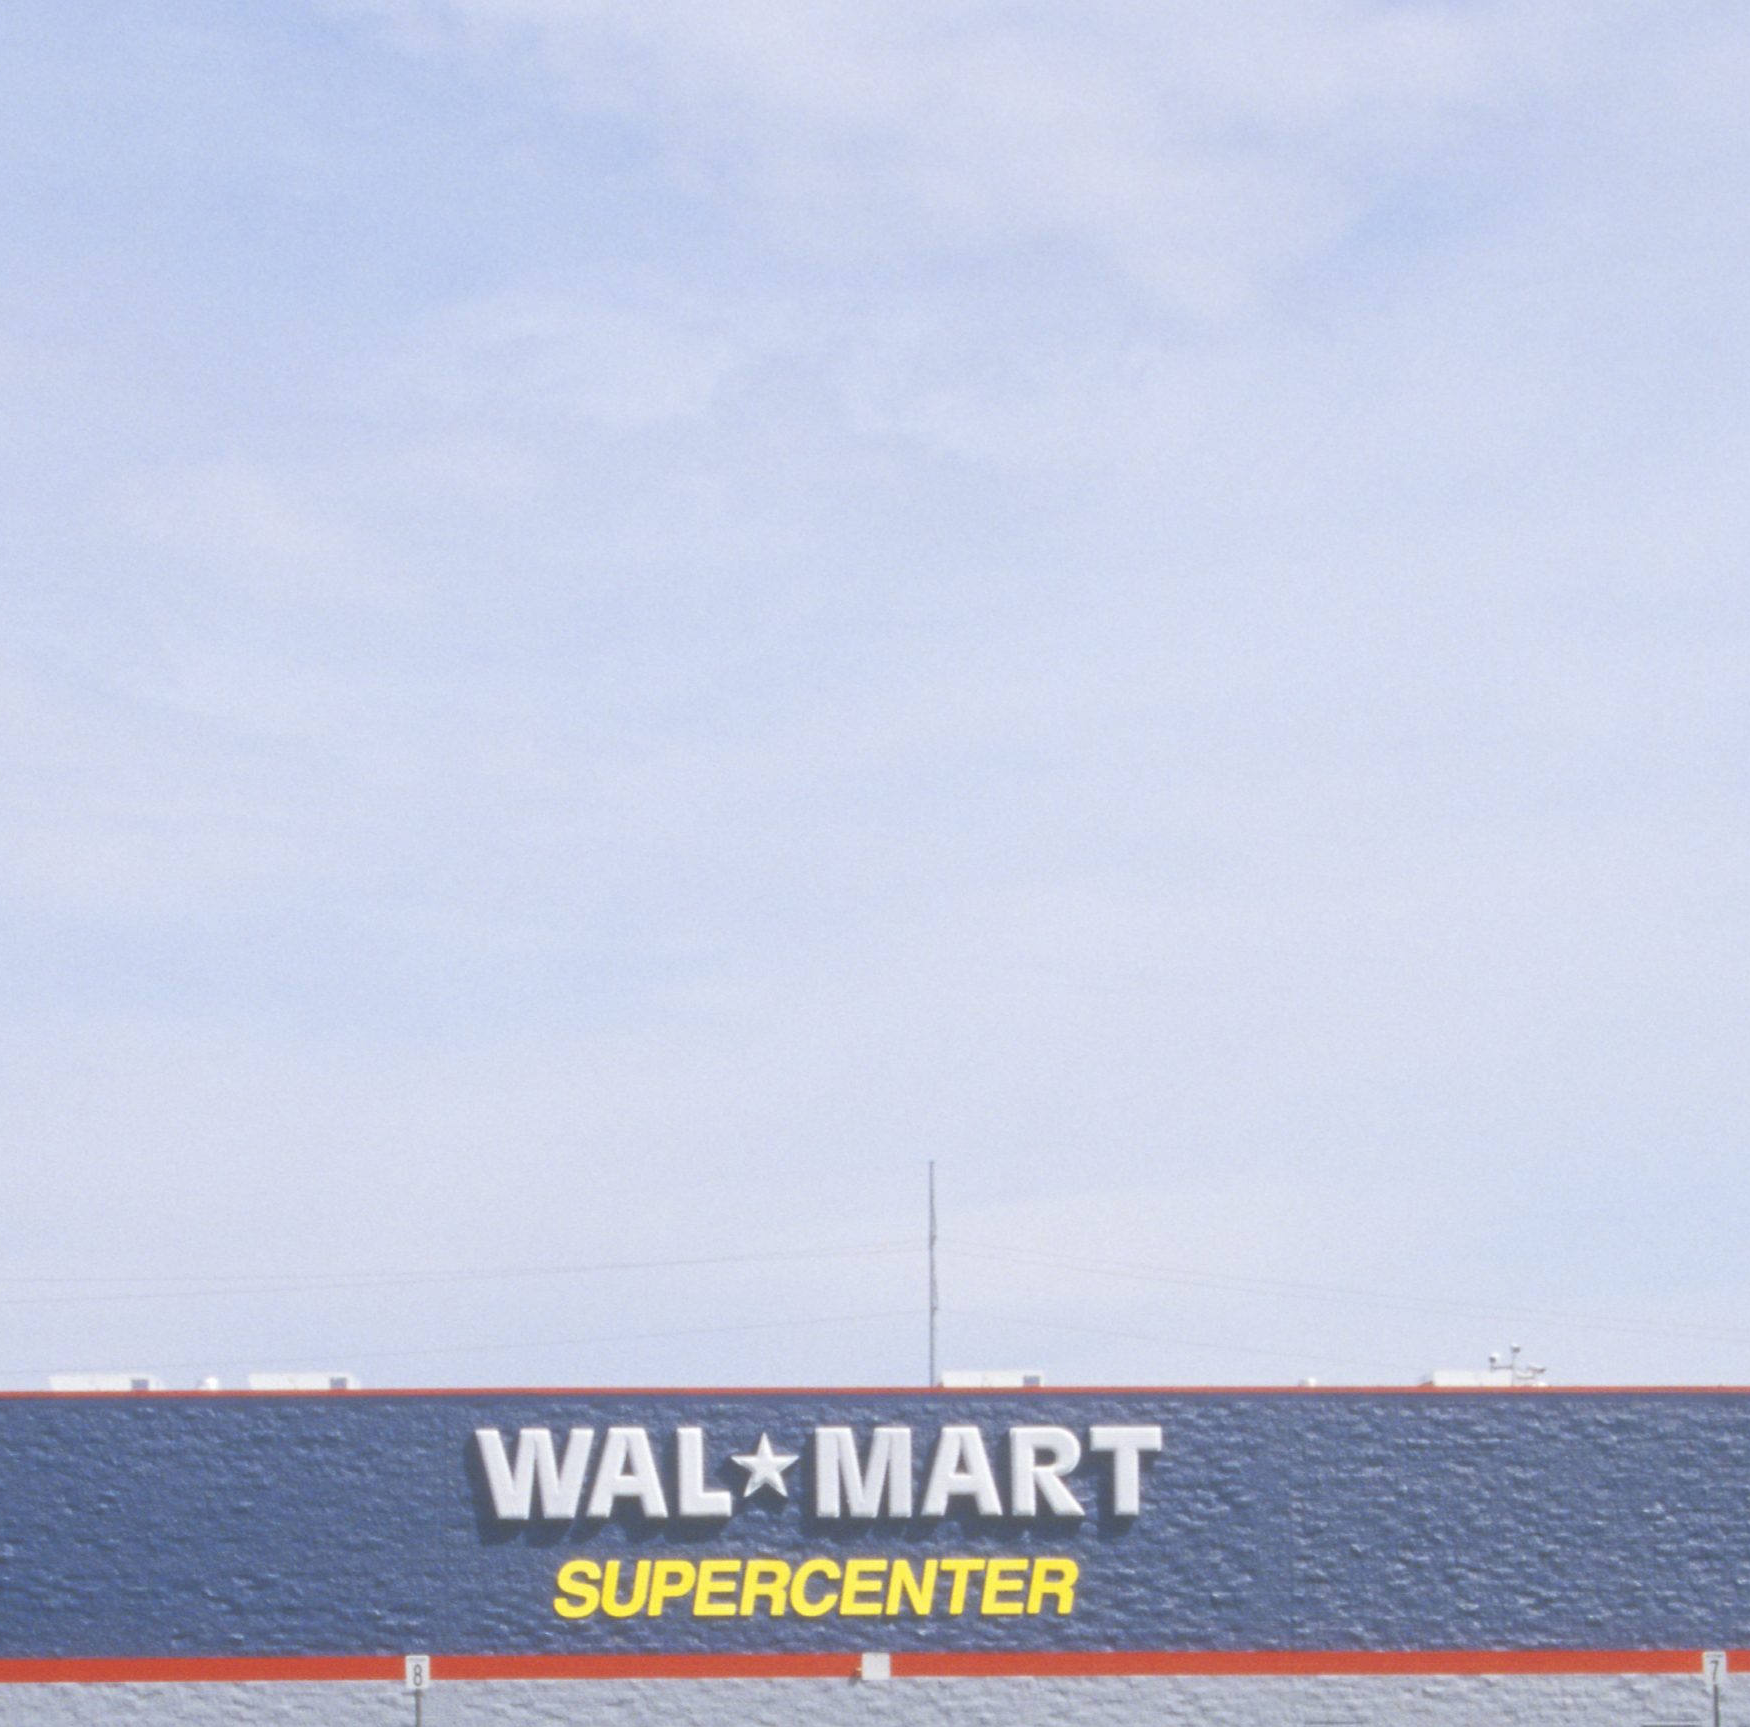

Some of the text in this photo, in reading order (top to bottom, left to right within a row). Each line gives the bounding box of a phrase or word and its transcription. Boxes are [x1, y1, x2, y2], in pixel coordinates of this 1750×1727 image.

[475, 1424, 1163, 1521] WAL MART
[552, 1556, 1080, 1620] SUPERCENTER
[413, 1664, 423, 1687] 8
[1710, 1660, 1719, 1682] 7
